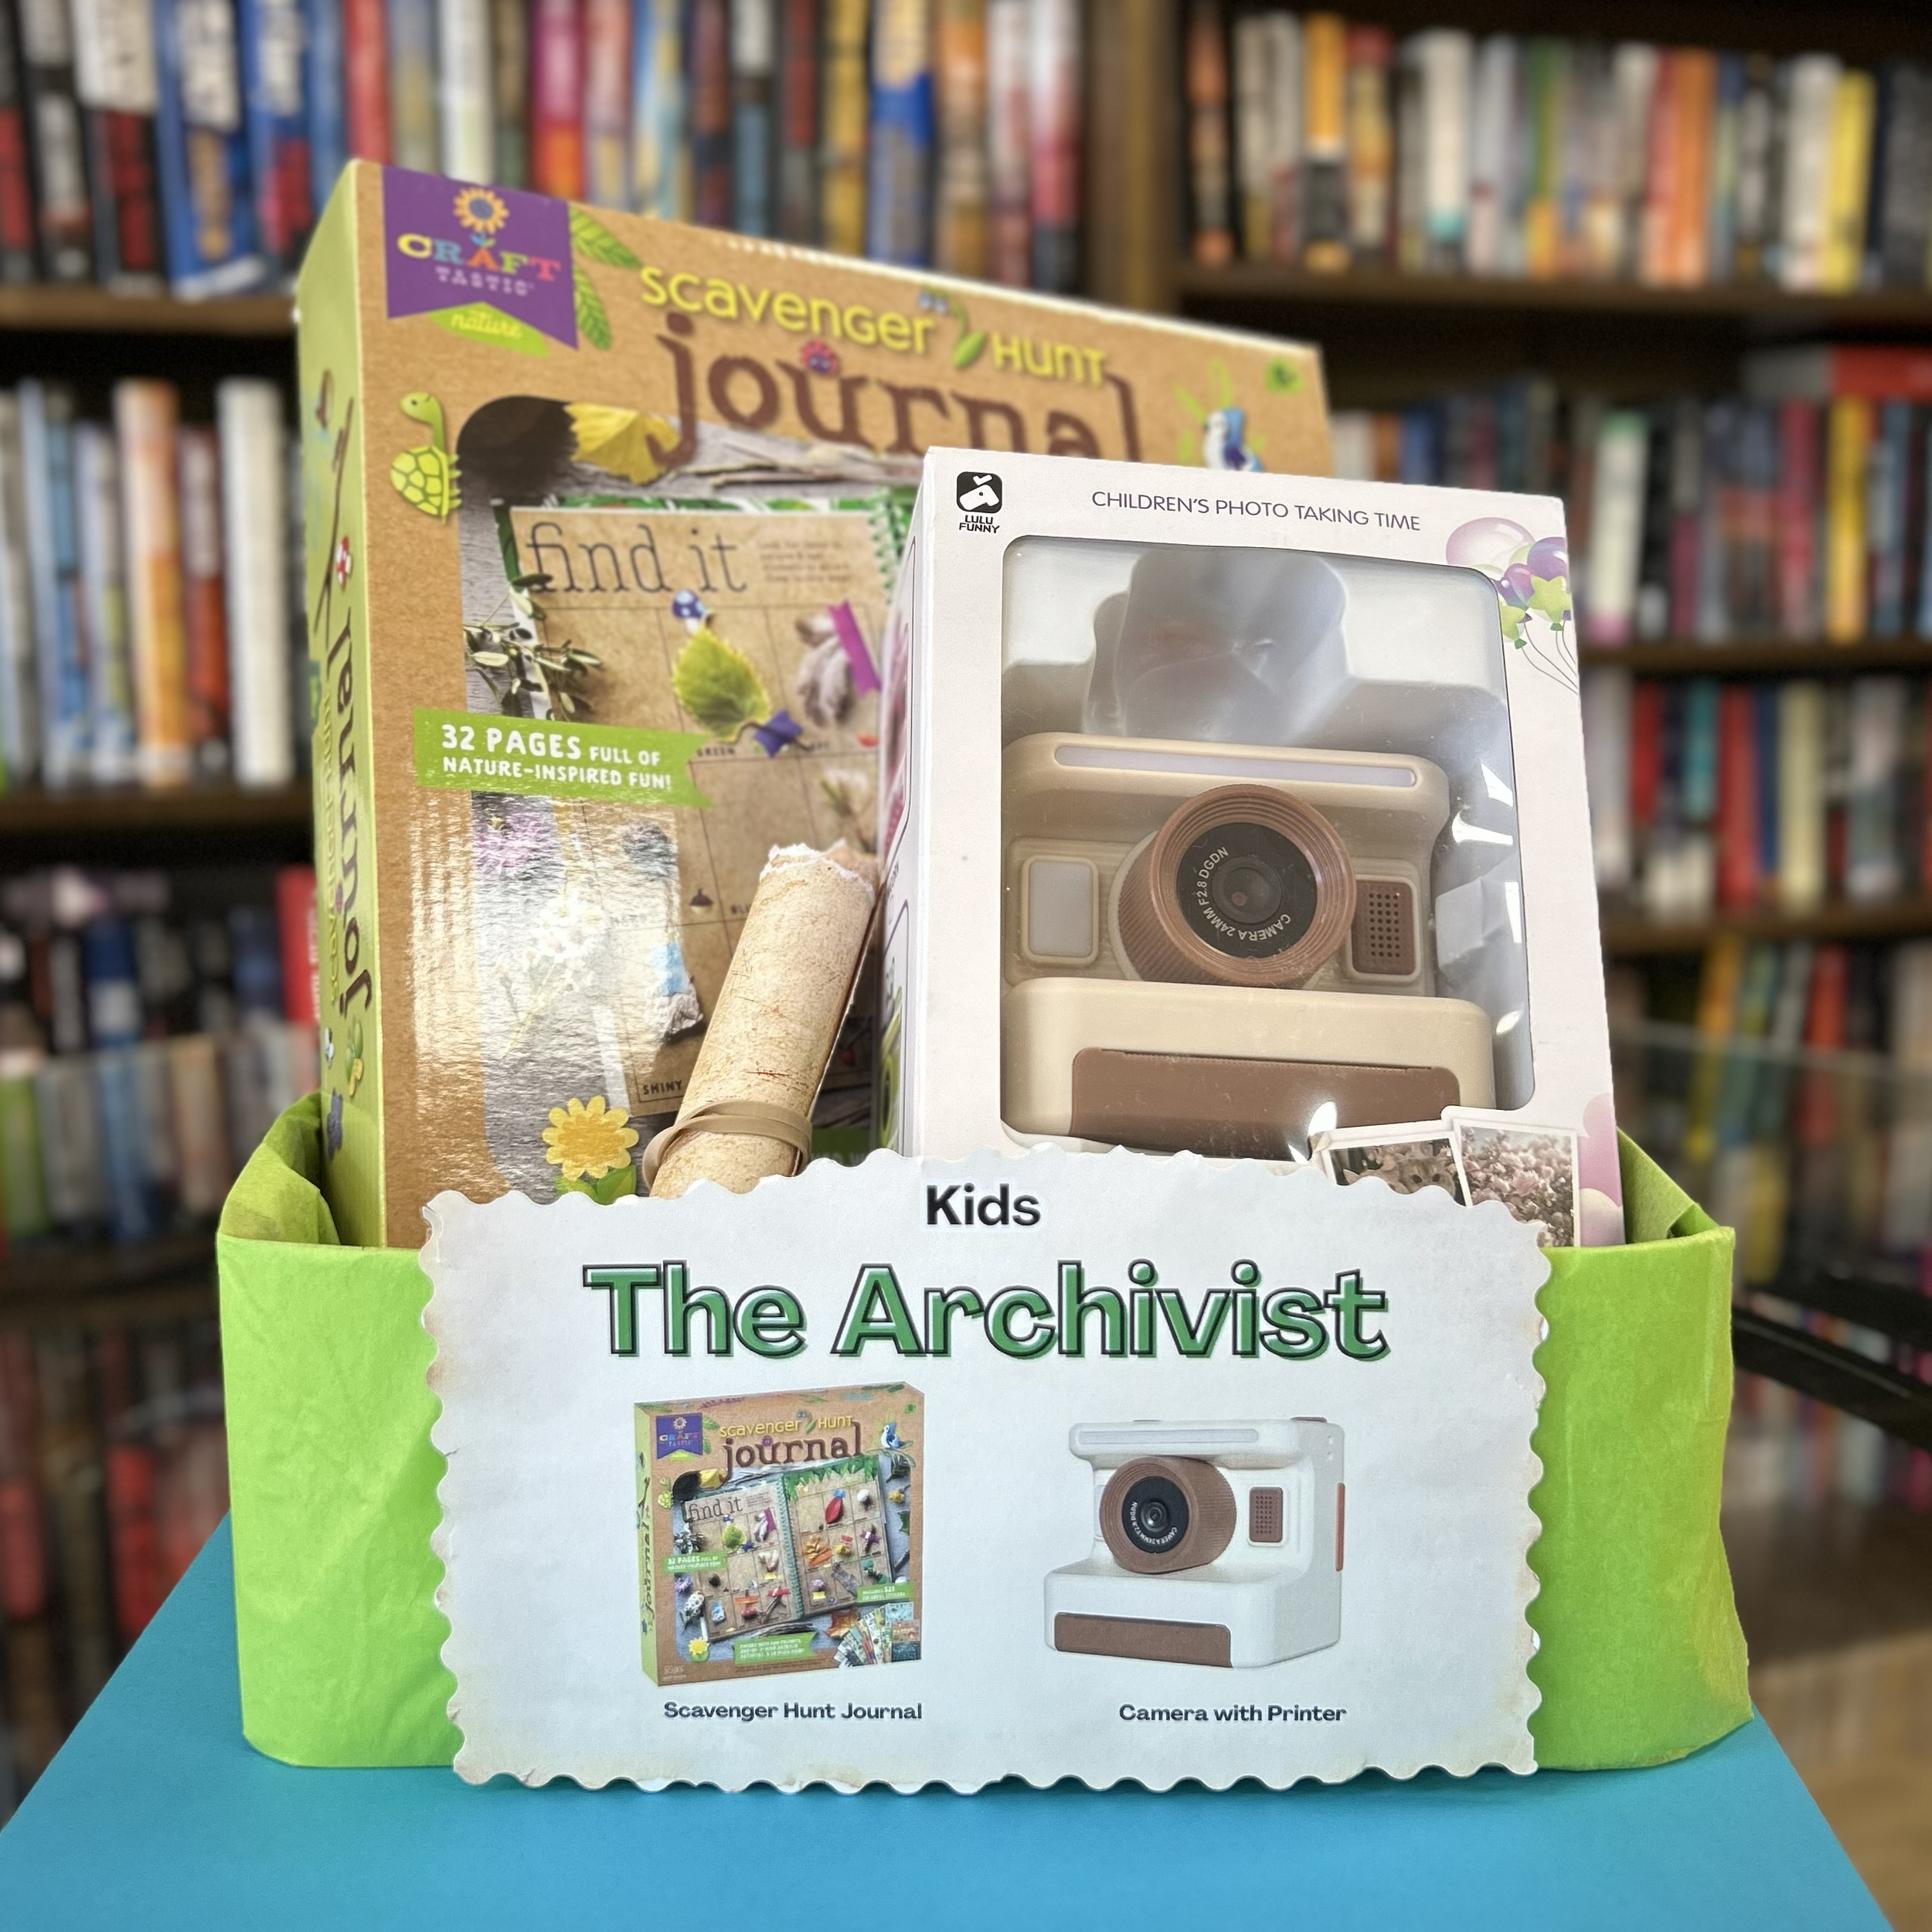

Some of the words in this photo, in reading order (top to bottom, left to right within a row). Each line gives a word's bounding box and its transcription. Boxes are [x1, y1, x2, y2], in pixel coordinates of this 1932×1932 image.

[397, 233, 561, 281] CRAFT
[451, 311, 523, 339] nature
[965, 515, 993, 525] LULU
[1091, 491, 1209, 514] CHILDREN'S
[1216, 499, 1288, 519] PHOTO
[1293, 504, 1369, 526] TAKING
[1374, 512, 1421, 531] TIME
[959, 522, 1000, 533] FUNNY
[526, 522, 672, 594] find
[689, 528, 747, 593] it
[441, 723, 476, 751] 32
[486, 727, 581, 760] PAGES
[589, 746, 632, 764] FULL
[638, 750, 660, 766] OF
[696, 747, 736, 757] GREEN
[443, 757, 622, 786] NATURE-INSPIRED
[628, 772, 672, 790] FUN!
[326, 608, 372, 1017] journal
[1199, 847, 1229, 879] DGDN
[1197, 880, 1209, 906] F2.8
[1202, 907, 1236, 937] 24MM
[1238, 913, 1291, 941] CAMERA
[643, 1080, 682, 1095] SHINY
[927, 1184, 1041, 1227] Kids
[583, 1260, 808, 1360] The
[831, 1260, 1391, 1361] Archivist
[719, 1421, 865, 1485] journal
[688, 1498, 724, 1521] find
[728, 1497, 743, 1514] it
[664, 1702, 778, 1723] Scavenger
[784, 1702, 835, 1720] Hunt
[840, 1702, 922, 1720] Journal
[1119, 1704, 1209, 1723] Camera
[1213, 1703, 1263, 1723] with
[1268, 1703, 1347, 1723] Printer
